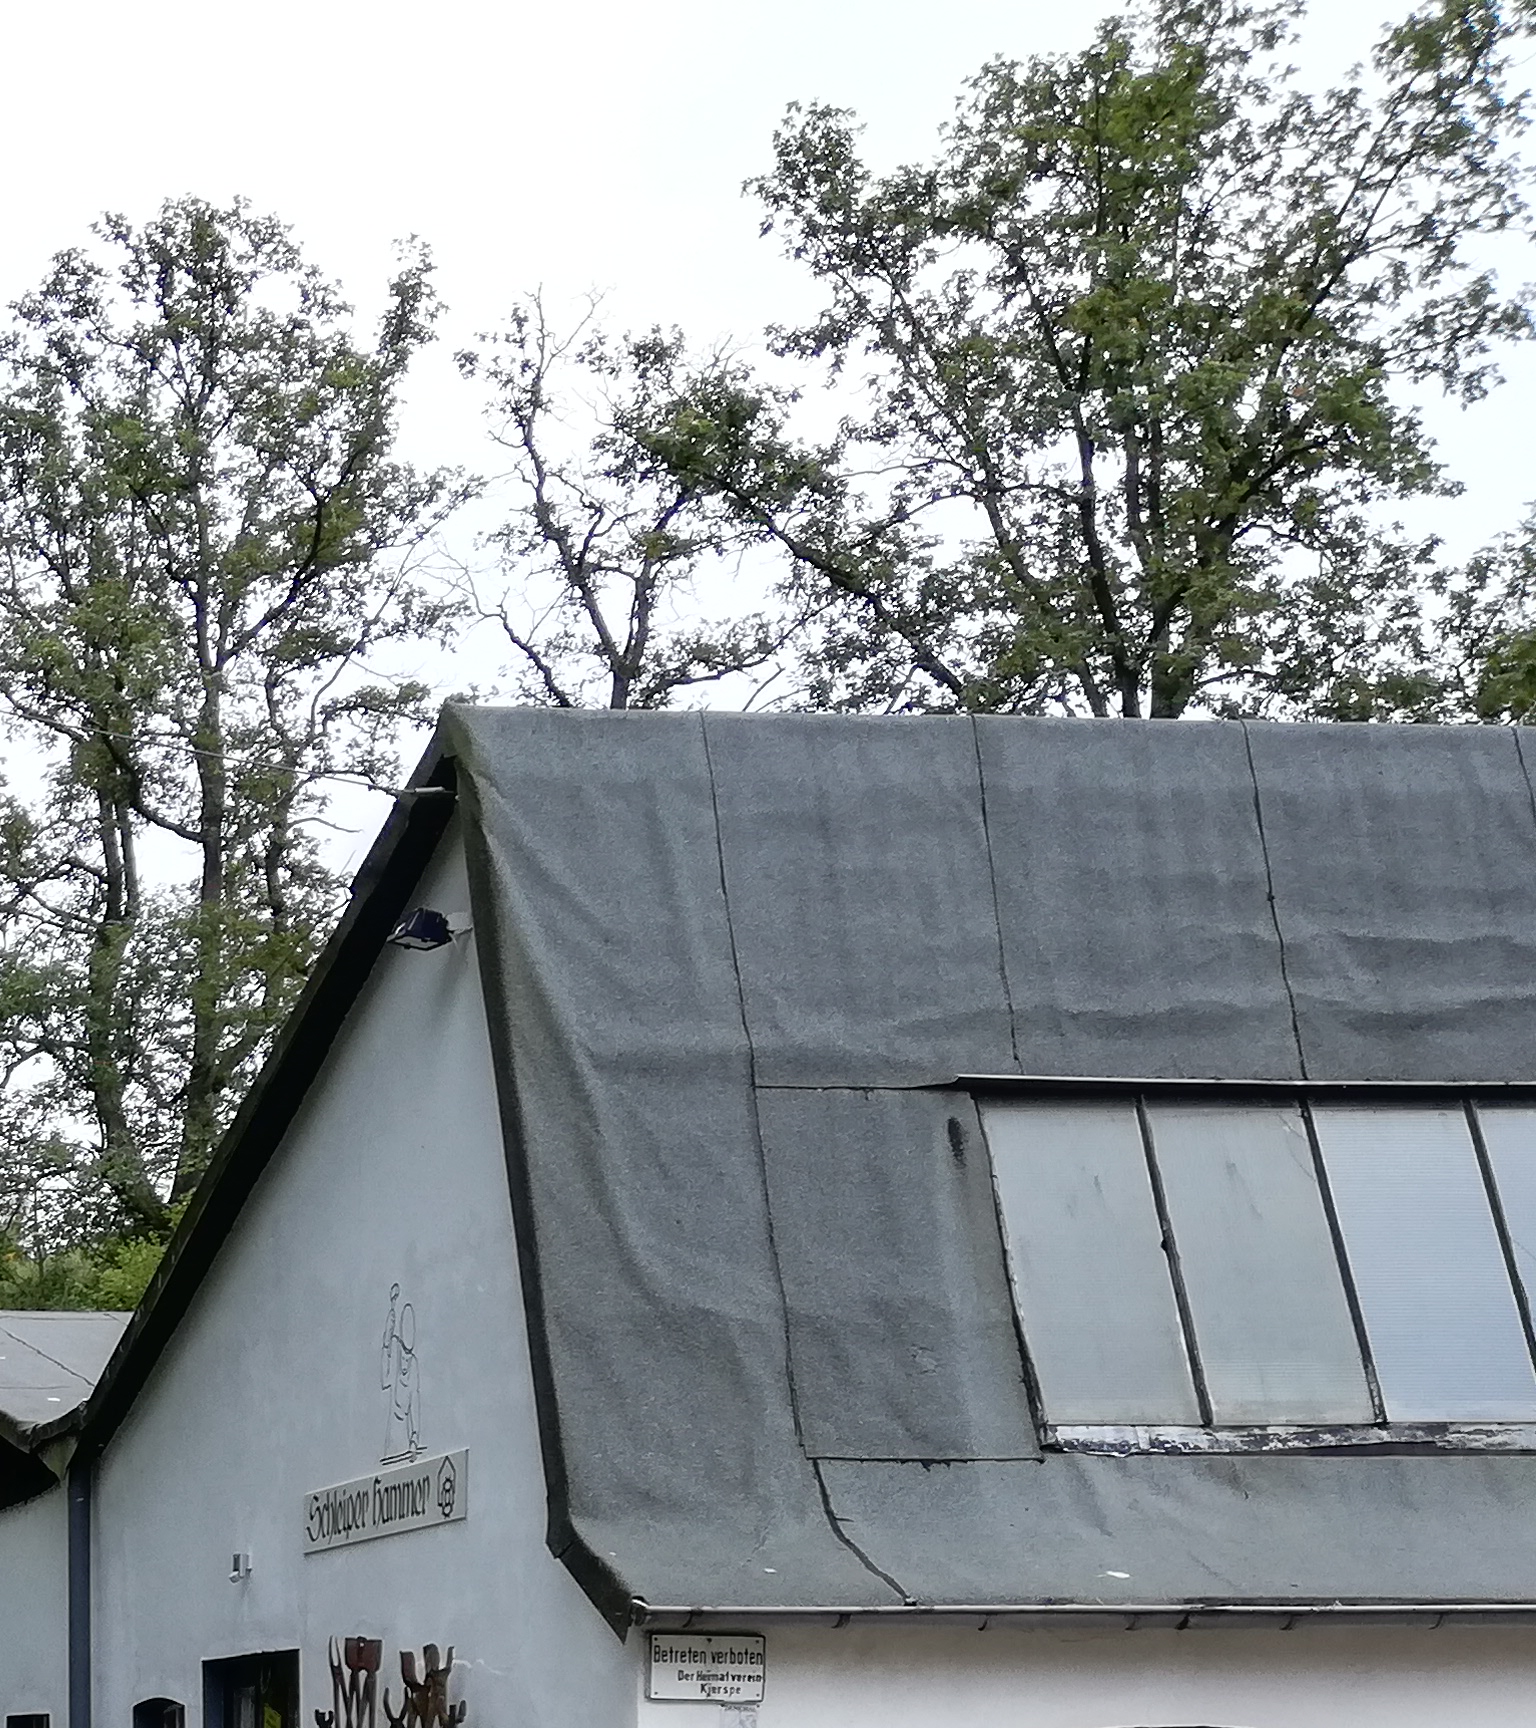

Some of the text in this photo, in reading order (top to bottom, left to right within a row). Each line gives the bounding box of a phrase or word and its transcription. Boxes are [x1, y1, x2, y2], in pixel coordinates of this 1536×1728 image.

[306, 1475, 431, 1544] Schleiper Hammer
[653, 1645, 764, 1665] Betreten verboten
[677, 1670, 694, 1681] Der
